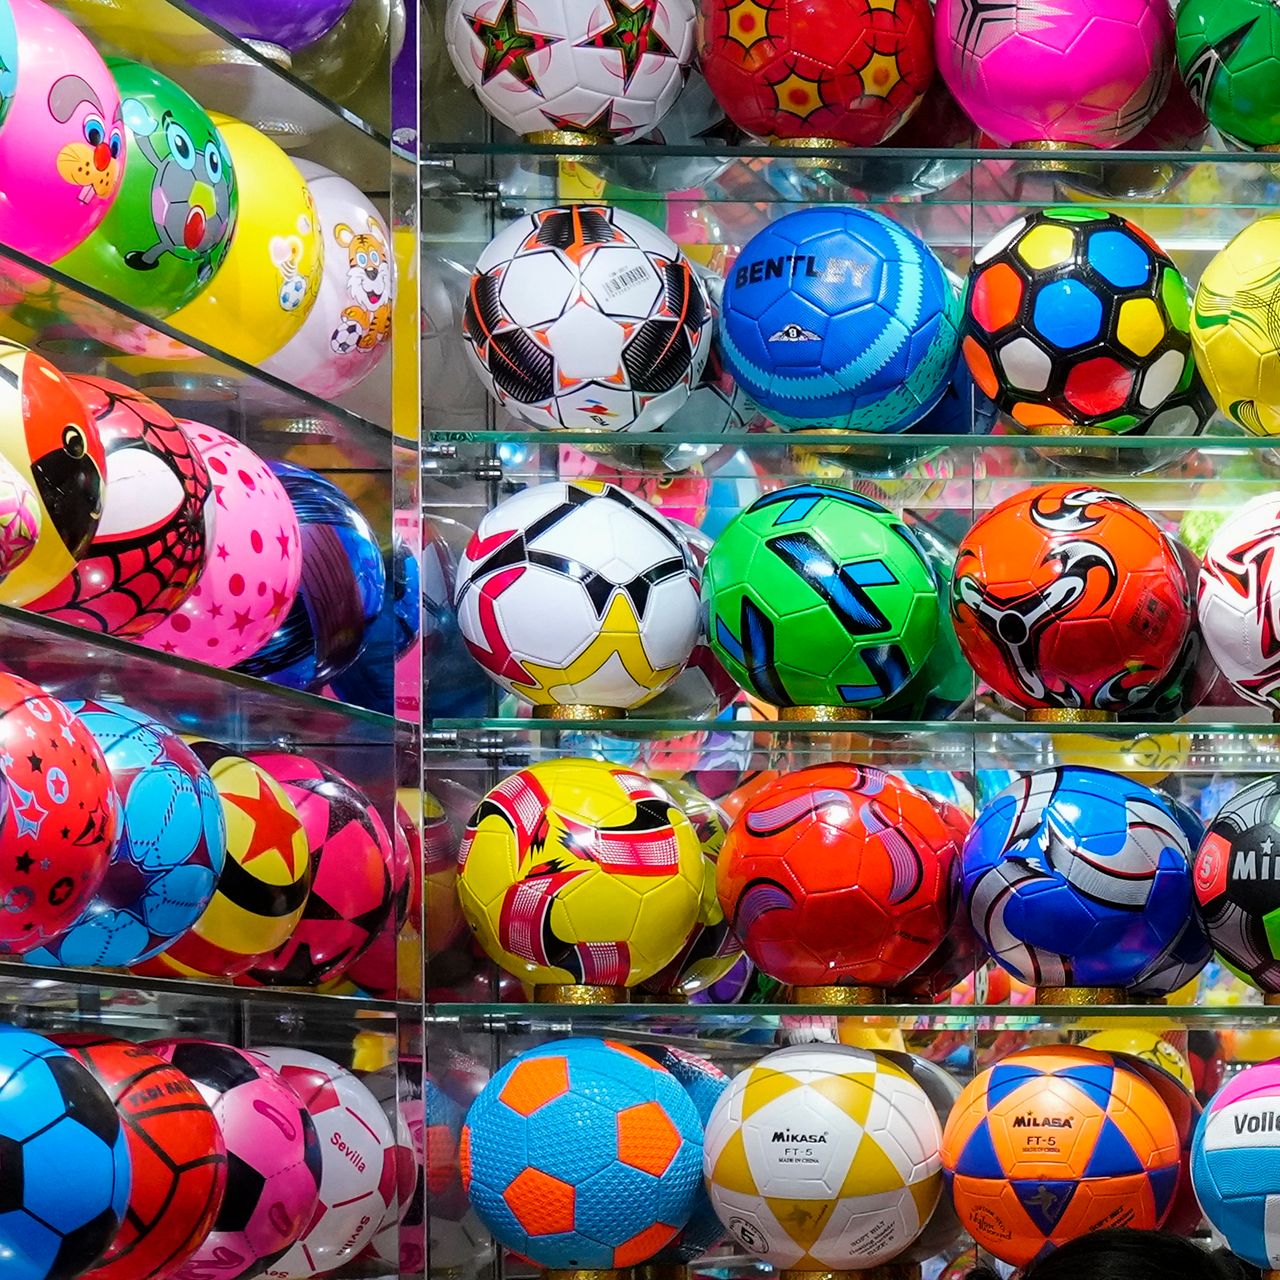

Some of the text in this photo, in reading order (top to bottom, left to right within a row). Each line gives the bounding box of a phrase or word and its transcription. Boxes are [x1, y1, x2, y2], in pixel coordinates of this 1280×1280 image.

[735, 255, 871, 289] BENTLEY
[330, 1132, 367, 1173] Sevilla
[784, 1148, 813, 1156] FT-5
[1026, 1136, 1056, 1146] FT-5
[335, 1215, 371, 1257] Sevilla
[740, 1227, 755, 1246] 5
